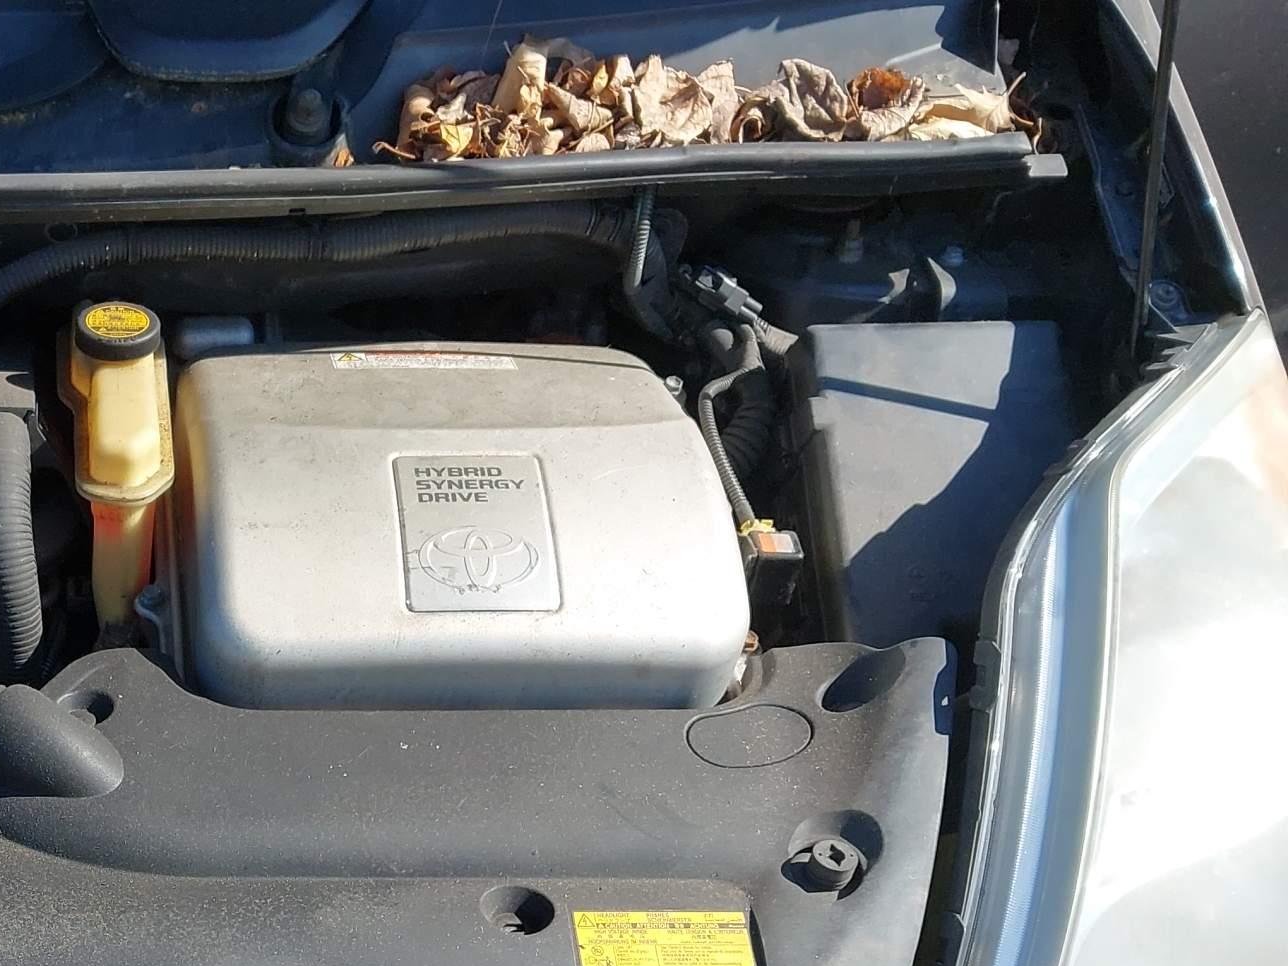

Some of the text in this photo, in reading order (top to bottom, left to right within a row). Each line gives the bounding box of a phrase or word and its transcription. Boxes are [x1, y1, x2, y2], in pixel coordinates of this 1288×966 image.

[414, 467, 502, 478] HYBRID
[415, 479, 525, 491] SYNERGY
[418, 492, 489, 503] DRIVE
